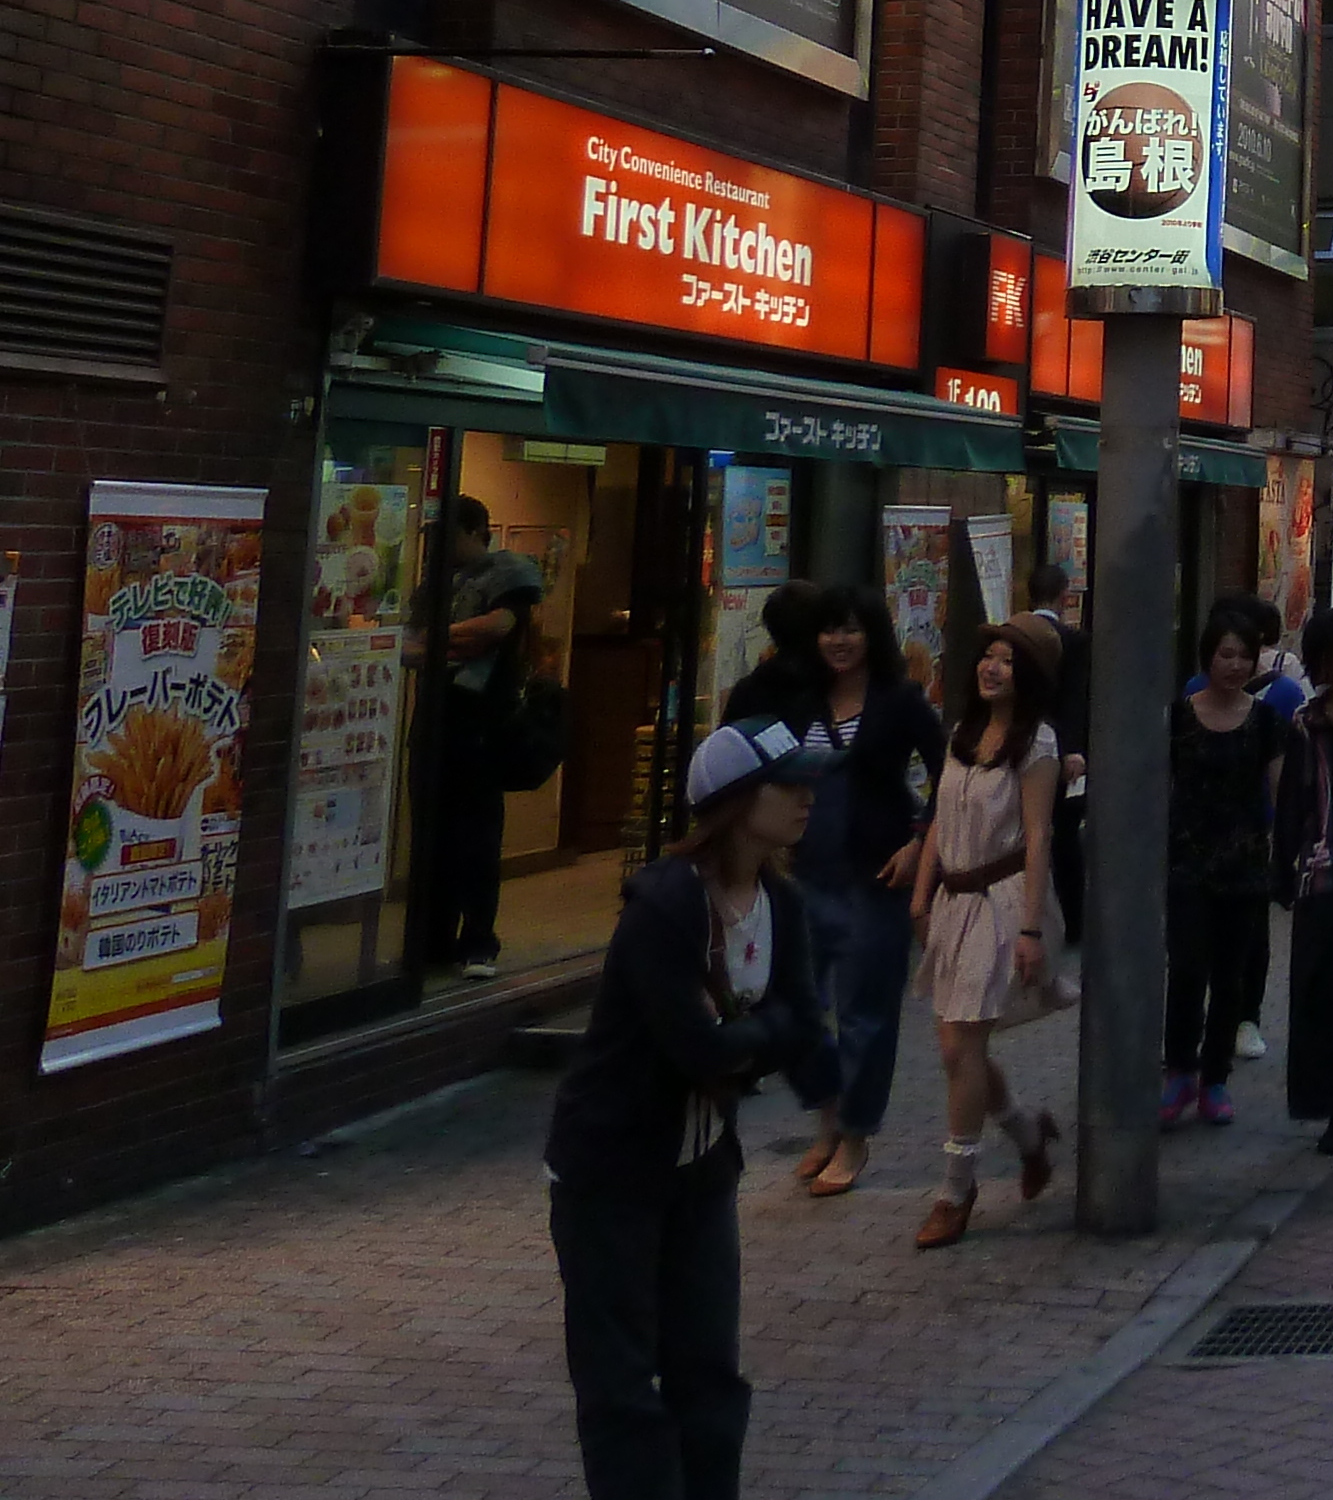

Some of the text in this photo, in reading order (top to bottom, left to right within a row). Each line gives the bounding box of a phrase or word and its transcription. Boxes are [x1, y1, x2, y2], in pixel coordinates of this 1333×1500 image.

[1084, 33, 1210, 73] DREAM!
[1086, 108, 1199, 138] がんばれ!
[587, 137, 770, 209] City Convenience Restaurant
[1085, 136, 1195, 195] 島根
[581, 176, 813, 286] First Kitchen
[1085, 249, 1190, 265] 渋谷センター街
[681, 275, 810, 328] ファースト キッチン
[991, 269, 1026, 327] FK
[947, 377, 961, 403] 1F
[765, 411, 882, 451] ファースト キッチン
[84, 668, 238, 741] フレーバーポテト
[92, 870, 197, 903] イタリアントマトポテト
